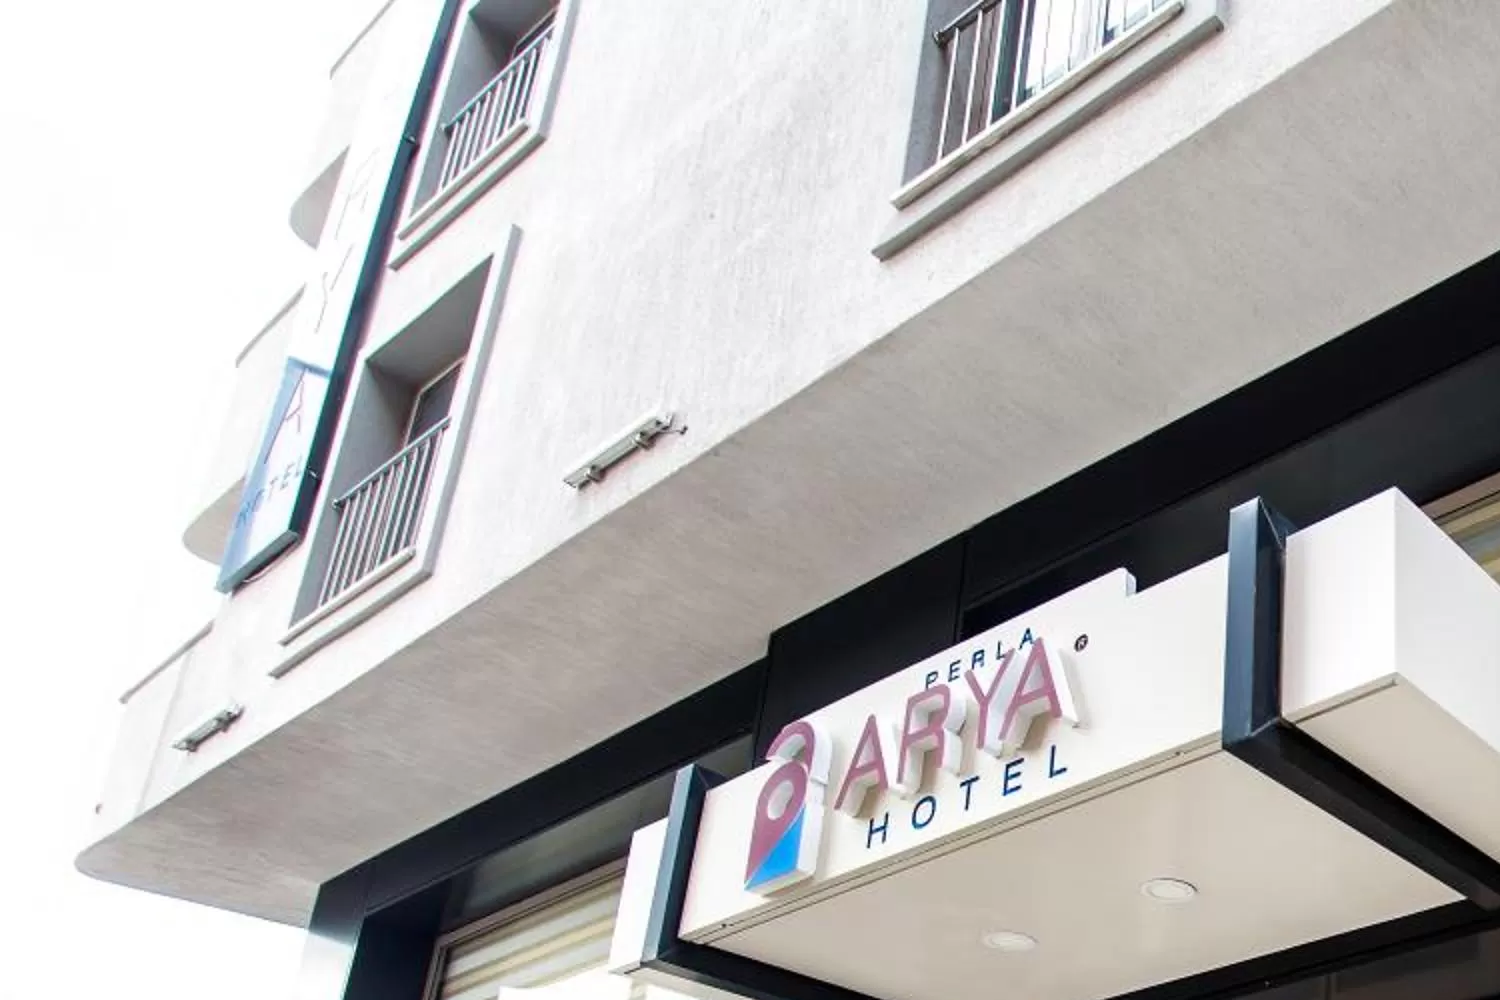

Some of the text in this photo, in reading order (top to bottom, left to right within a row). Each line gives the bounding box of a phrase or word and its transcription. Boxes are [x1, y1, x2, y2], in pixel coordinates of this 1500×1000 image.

[925, 627, 1034, 690] PERLA
[834, 637, 1066, 812] ARYA
[866, 745, 1068, 849] HOTEL
